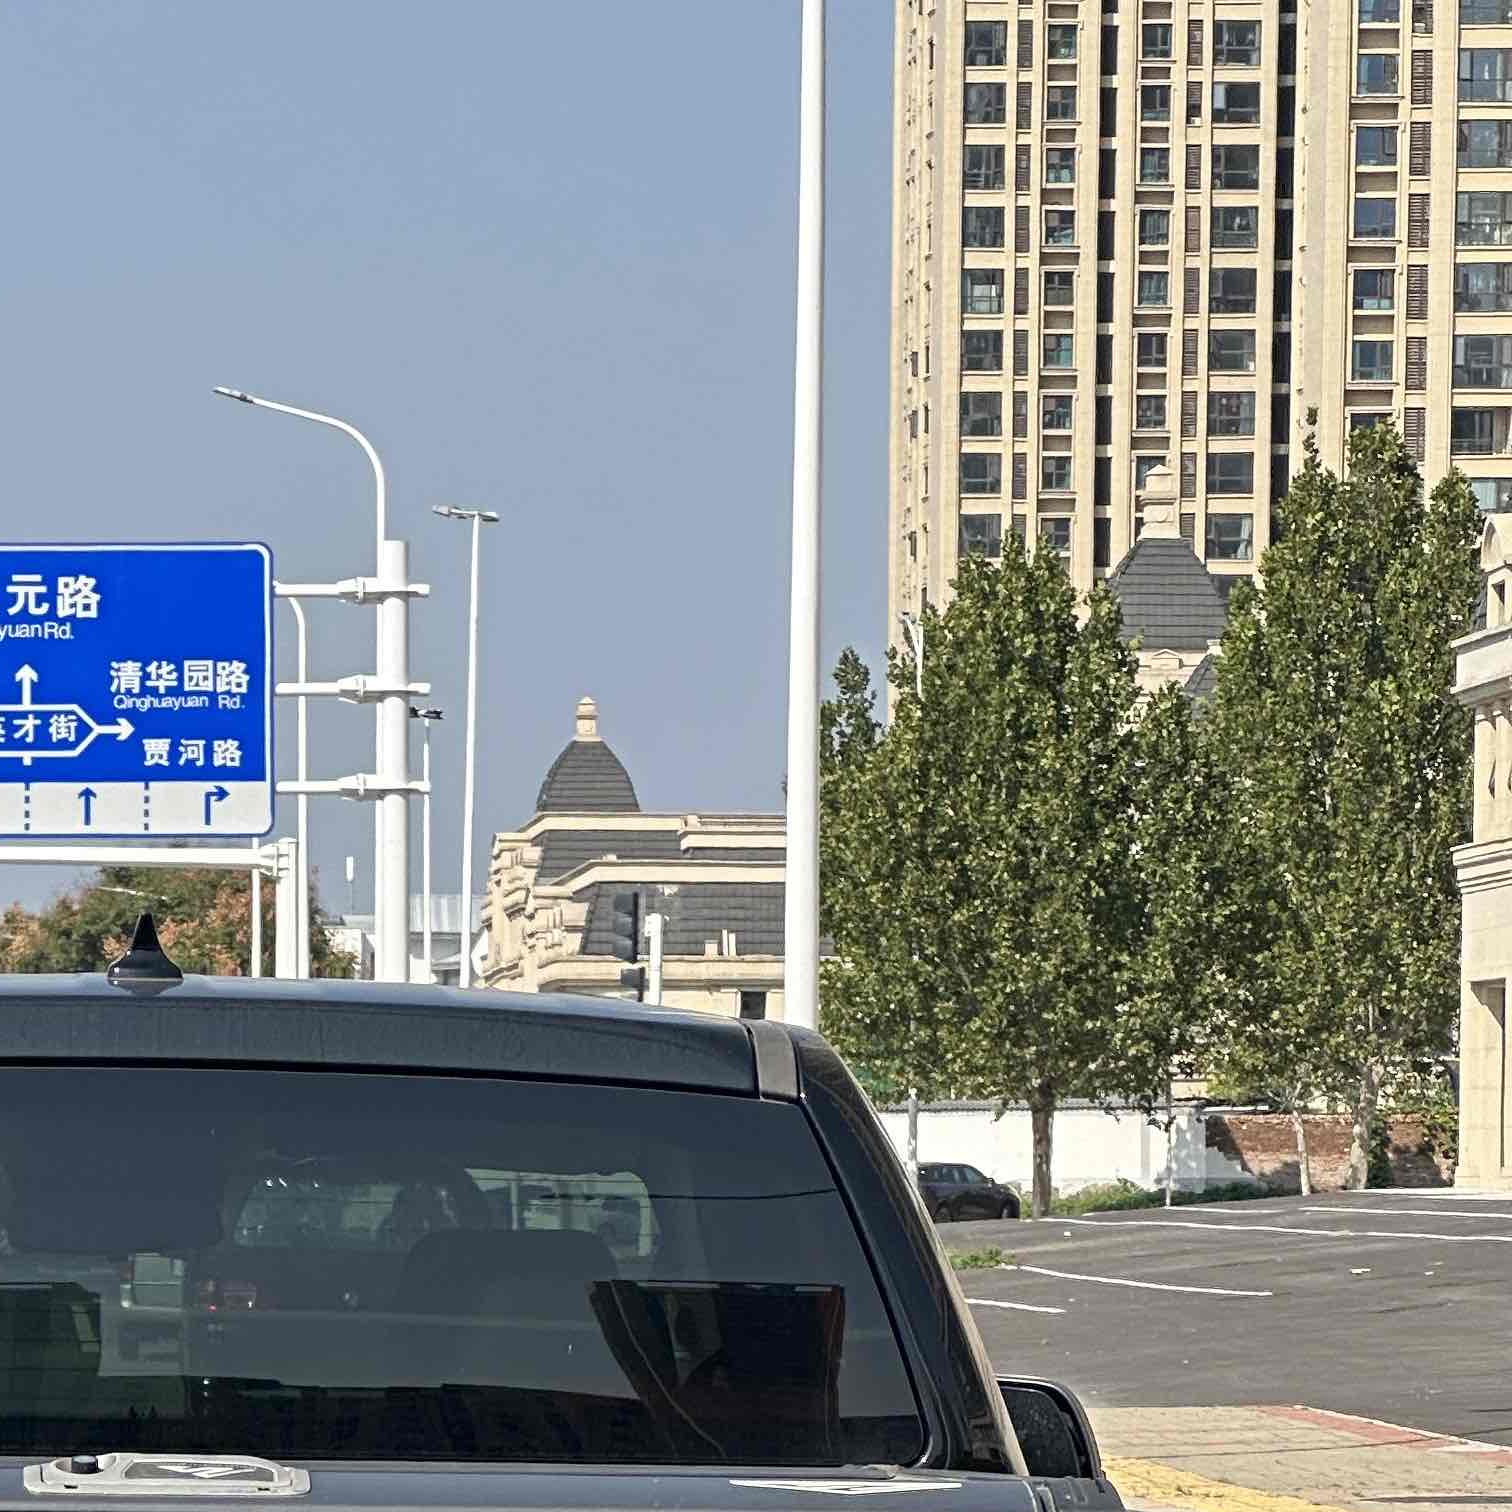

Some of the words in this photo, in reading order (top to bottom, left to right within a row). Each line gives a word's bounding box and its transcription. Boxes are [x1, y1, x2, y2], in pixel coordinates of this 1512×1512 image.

[44, 621, 75, 639] Rd.
[110, 660, 250, 694] 清华园路
[113, 694, 209, 712] Qinghuayuan
[218, 694, 246, 709] Rd.
[142, 738, 242, 767] 贾河路
